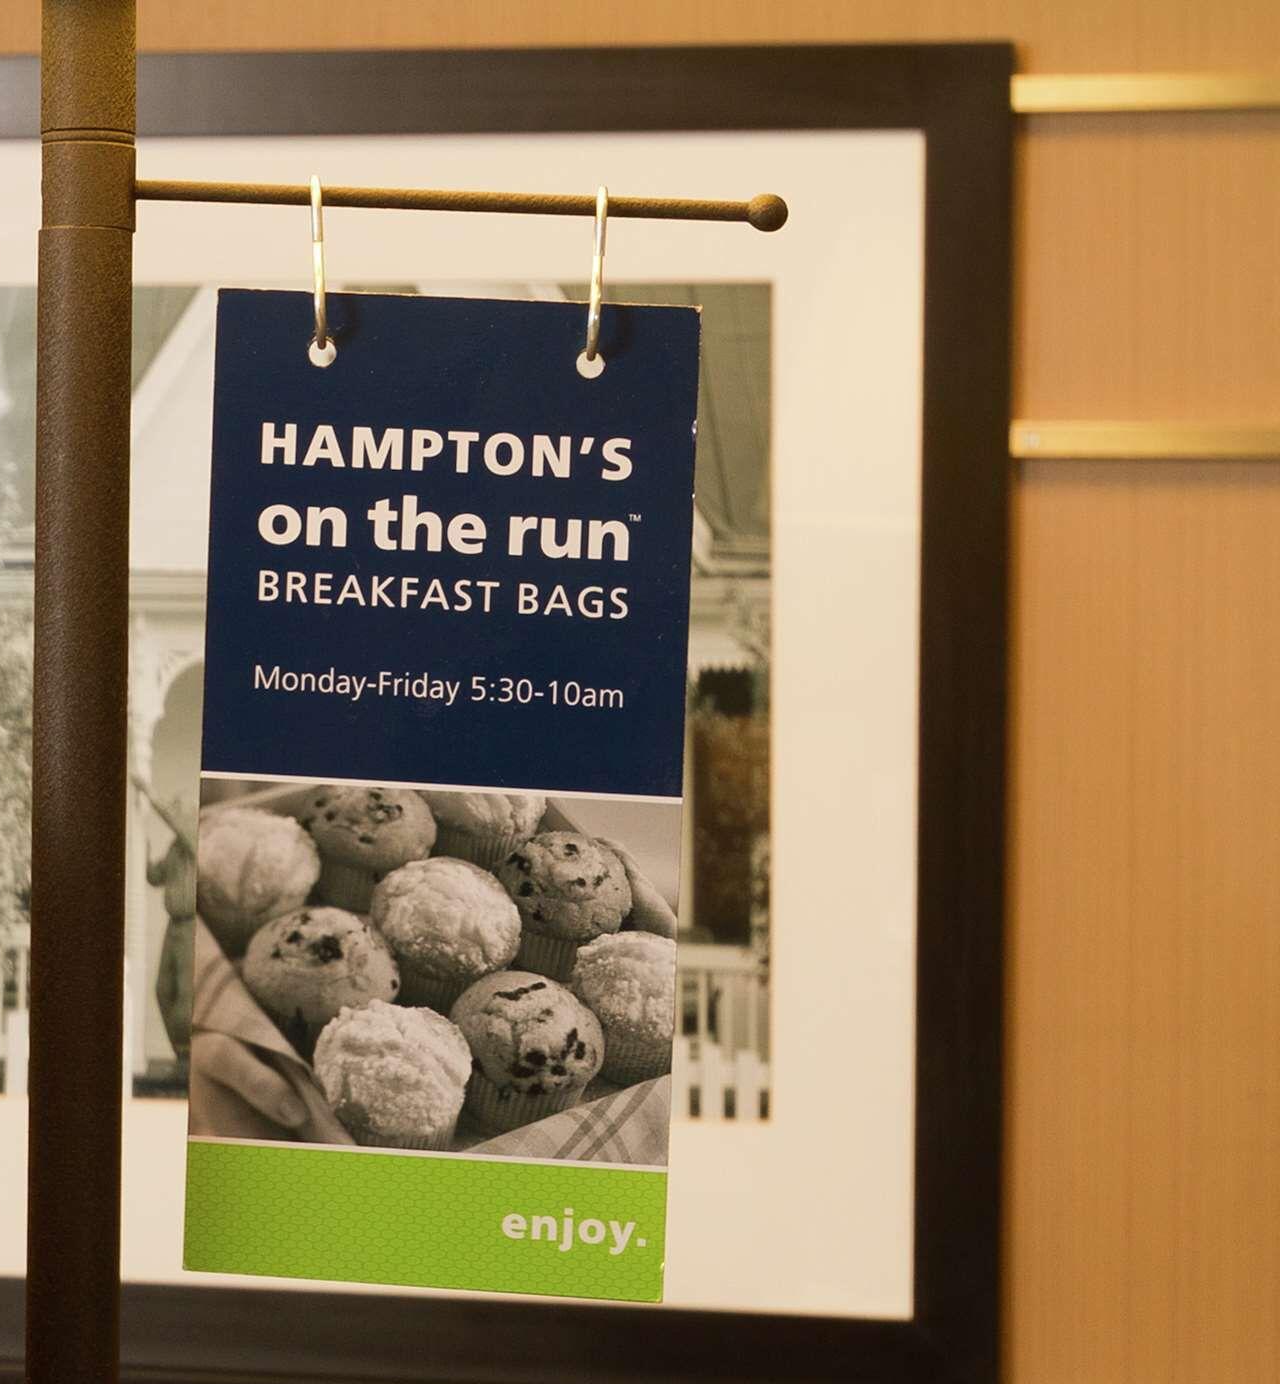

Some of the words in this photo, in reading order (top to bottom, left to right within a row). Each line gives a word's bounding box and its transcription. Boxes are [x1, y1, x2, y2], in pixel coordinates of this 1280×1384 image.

[260, 421, 634, 482] HAMPTON'S
[257, 503, 348, 548] on
[367, 494, 488, 555] the
[257, 569, 501, 613] BREAKFAST
[517, 582, 630, 620] BAGS
[253, 663, 460, 705] Monday-Friday
[470, 675, 625, 709] 5:30-10am
[501, 1207, 647, 1256] enjoy.
